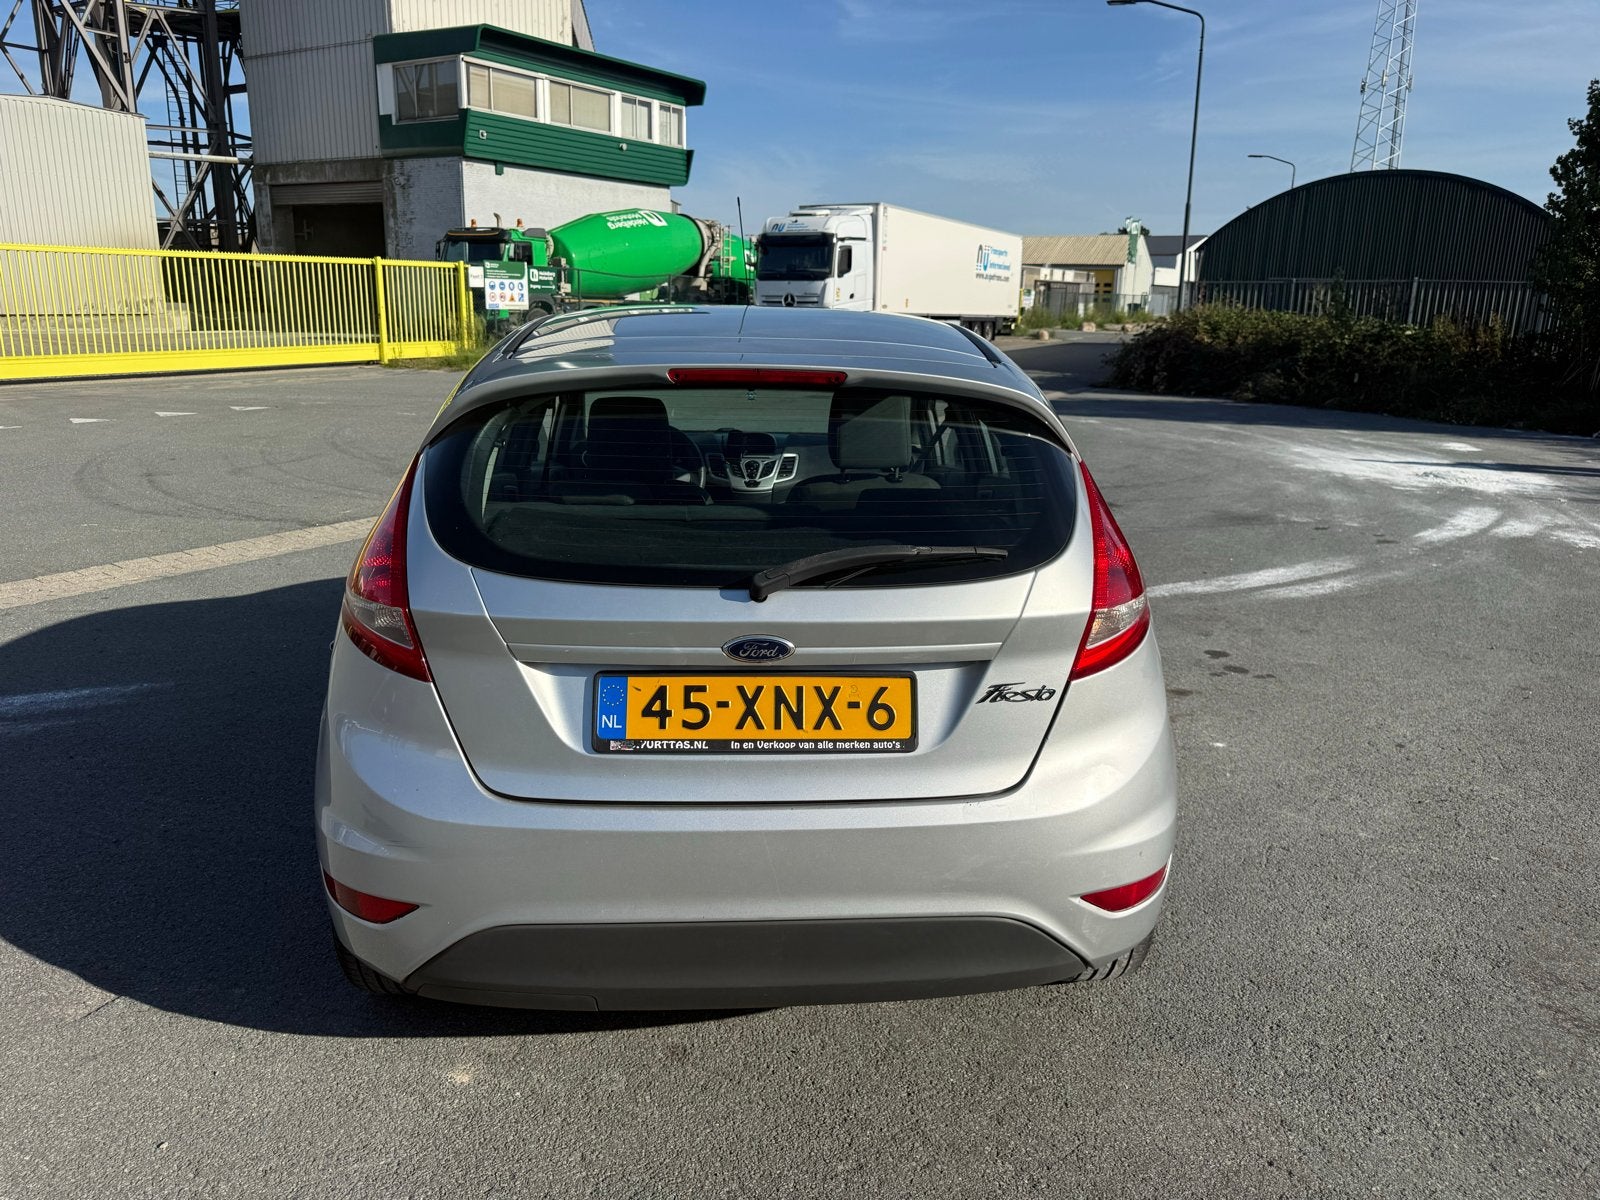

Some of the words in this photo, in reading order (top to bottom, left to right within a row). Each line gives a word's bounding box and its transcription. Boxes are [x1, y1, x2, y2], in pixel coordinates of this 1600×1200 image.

[739, 641, 779, 658] Ford
[975, 682, 1056, 704] Fiesta
[641, 685, 897, 731] 45-XNX-6
[602, 714, 622, 728] NL
[730, 740, 740, 749] In
[757, 740, 796, 750] Verkoop
[799, 741, 815, 749] van
[817, 740, 833, 749] alle
[836, 740, 871, 749] merken
